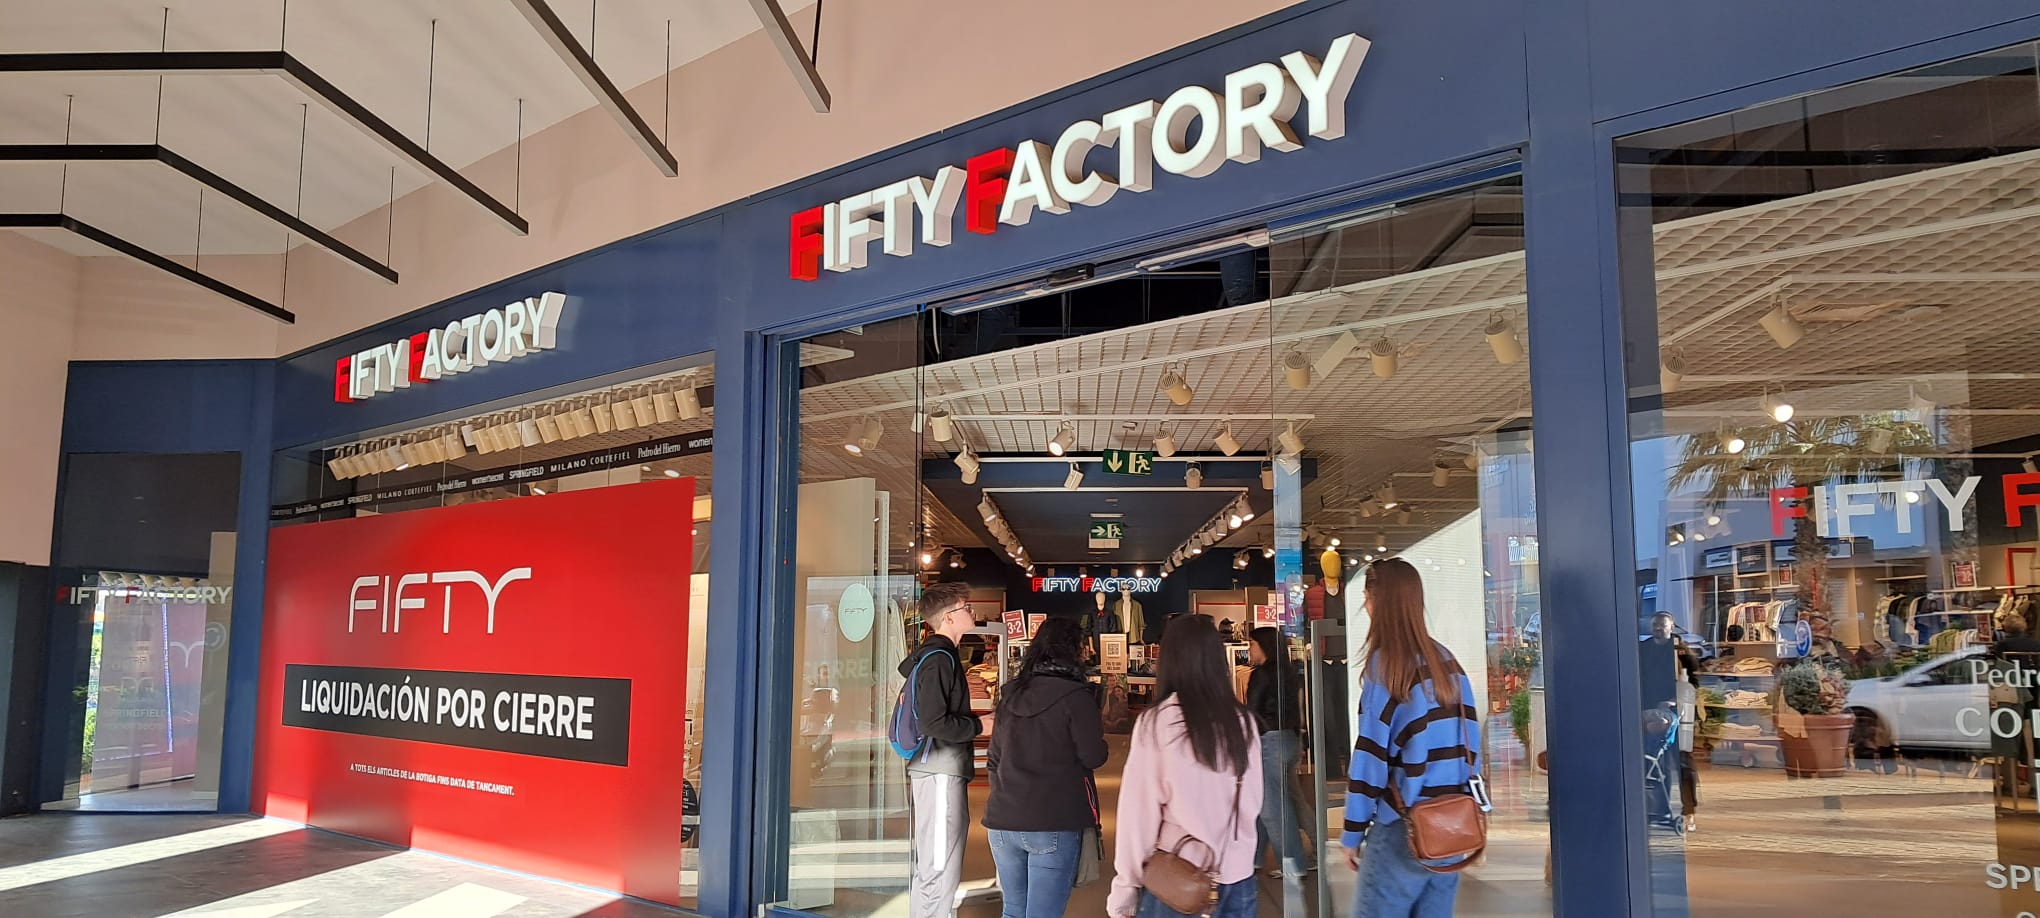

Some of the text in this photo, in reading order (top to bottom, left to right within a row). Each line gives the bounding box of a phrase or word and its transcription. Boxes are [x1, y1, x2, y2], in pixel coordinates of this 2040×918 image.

[790, 33, 1371, 281] FIFTY FACTORY
[335, 291, 566, 403] FIFTY FACTORY
[509, 466, 544, 480] SPRINGFIELD
[551, 459, 586, 472] MILANO
[590, 452, 630, 465] CORTEFIEL
[637, 446, 653, 458] Pedro
[653, 444, 662, 455] del
[662, 442, 681, 454] Hierro
[1769, 475, 1982, 537] FIFTY
[56, 585, 232, 605] FIFT FACTORY
[349, 567, 532, 634] FIFTY
[1032, 577, 1161, 592] FIFTY FACTORY
[1968, 658, 2040, 688] Pedr
[300, 676, 595, 740] LIQUIDACIÓN POR CIERRE
[1955, 707, 2040, 738] CO
[350, 763, 515, 796] A TOTS ELS ARTICLES DE LA BOTIGA FINS DATA DE TANCAMENT.
[1985, 863, 2040, 891] SP
